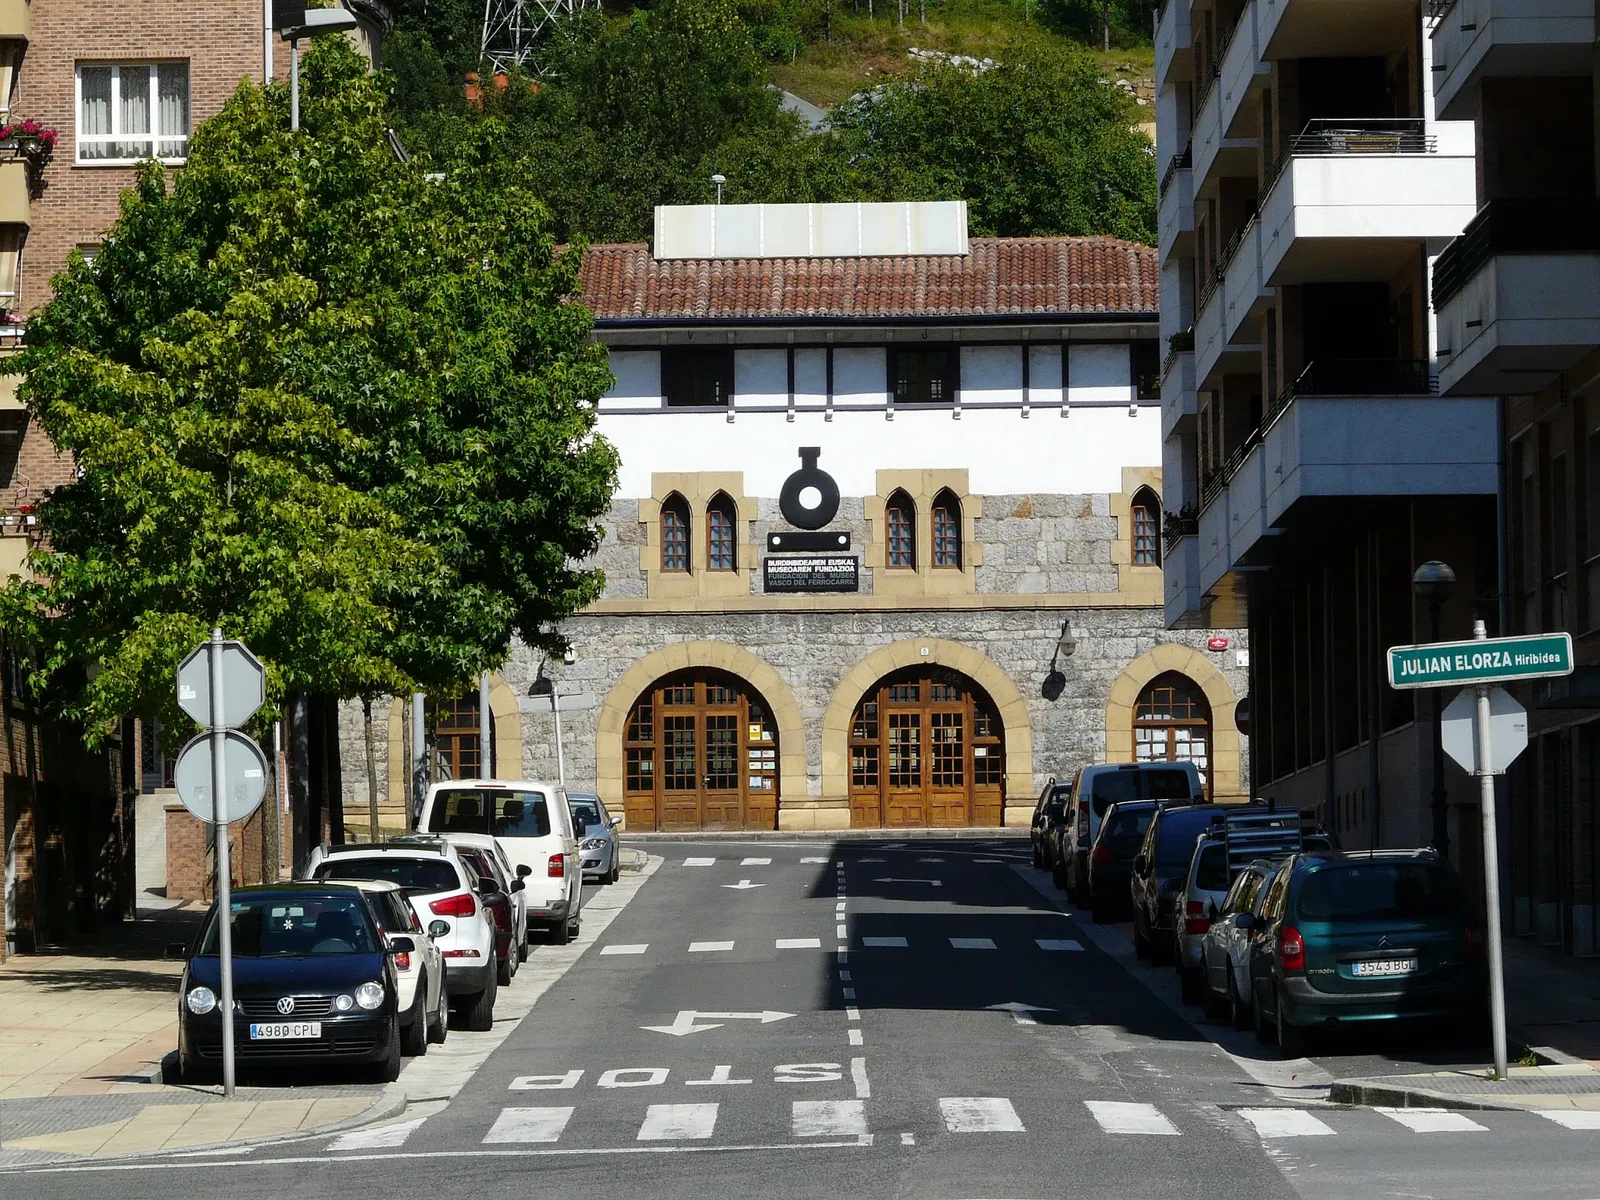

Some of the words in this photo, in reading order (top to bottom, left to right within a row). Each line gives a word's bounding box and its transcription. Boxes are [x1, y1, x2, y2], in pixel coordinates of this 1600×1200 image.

[1401, 656, 1451, 676] JULIAN
[1455, 651, 1512, 671] ELORZA
[1515, 653, 1561, 666] Hiribidea
[1360, 962, 1391, 972] 3543
[1394, 960, 1416, 970] BGL
[277, 997, 294, 1014] VW
[258, 1026, 289, 1036] 4980
[294, 1025, 318, 1036] CPL
[508, 1062, 843, 1090] STOP
